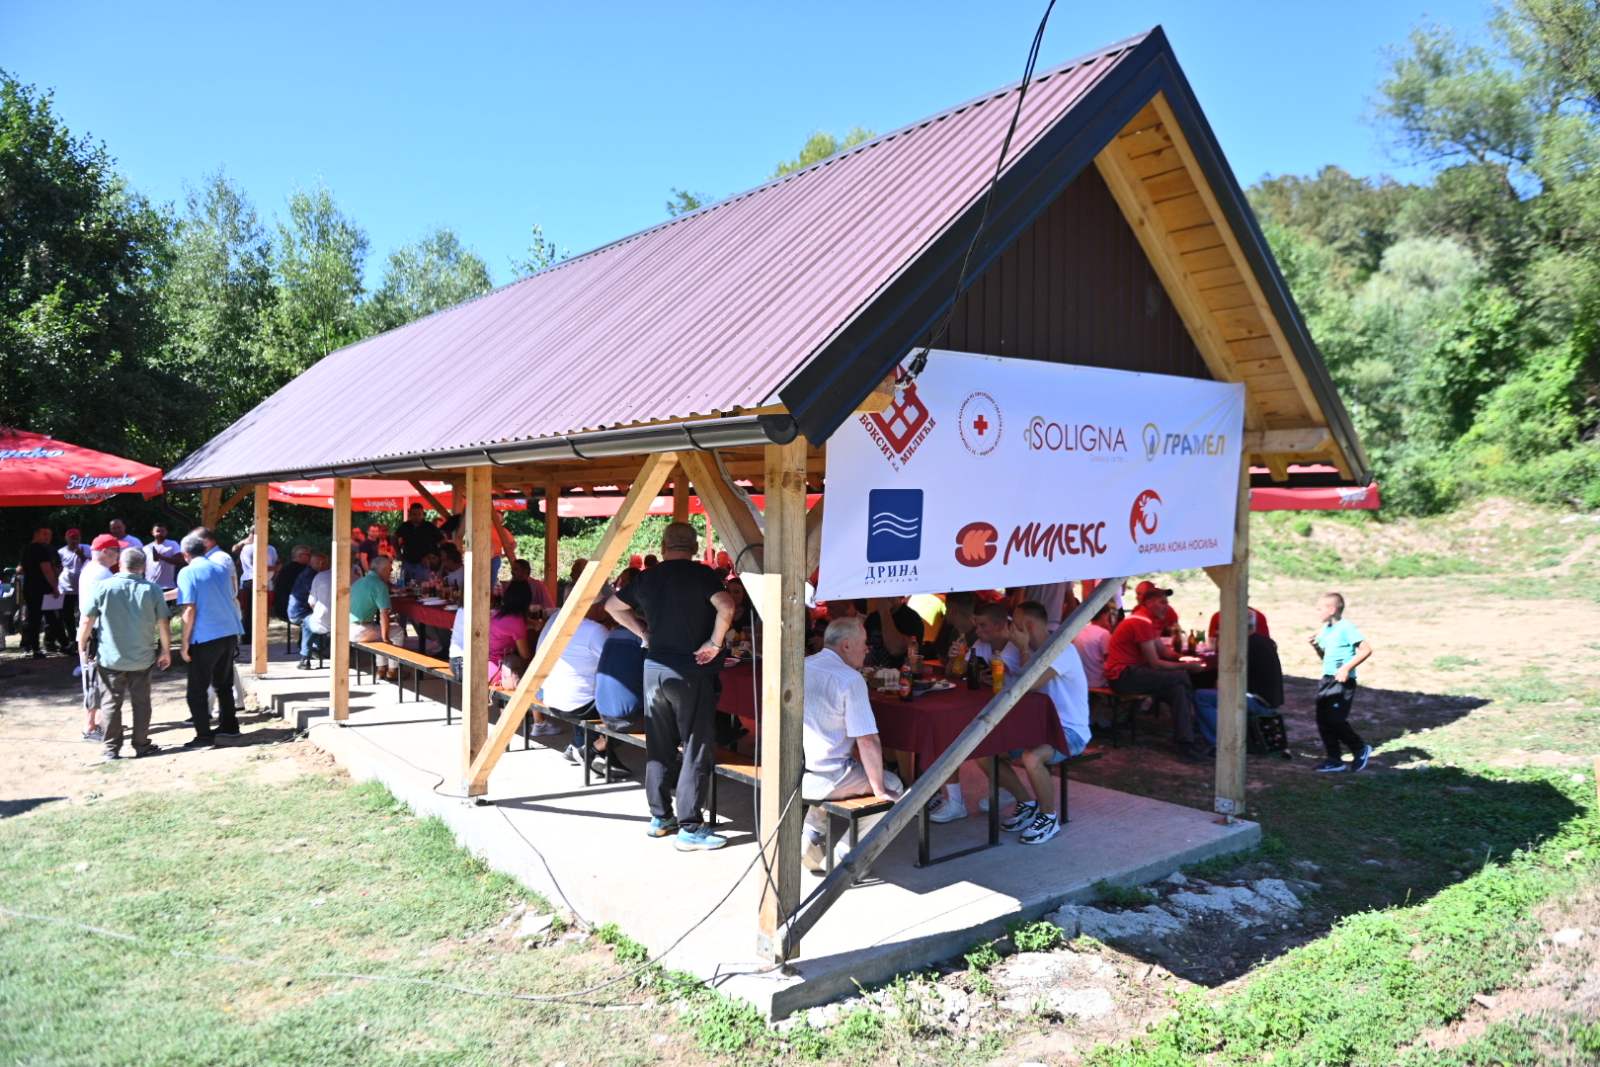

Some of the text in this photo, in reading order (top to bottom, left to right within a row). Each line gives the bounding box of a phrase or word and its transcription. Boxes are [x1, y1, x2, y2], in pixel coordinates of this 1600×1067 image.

[859, 414, 895, 461] БОКСИТ
[1030, 421, 1127, 452] SOLIGNA
[1163, 432, 1226, 456] ГРАМЕЛ
[1003, 521, 1107, 565] МИЛЕКС
[1138, 543, 1166, 554] ФАРМА
[865, 564, 918, 580] ДРИНА
